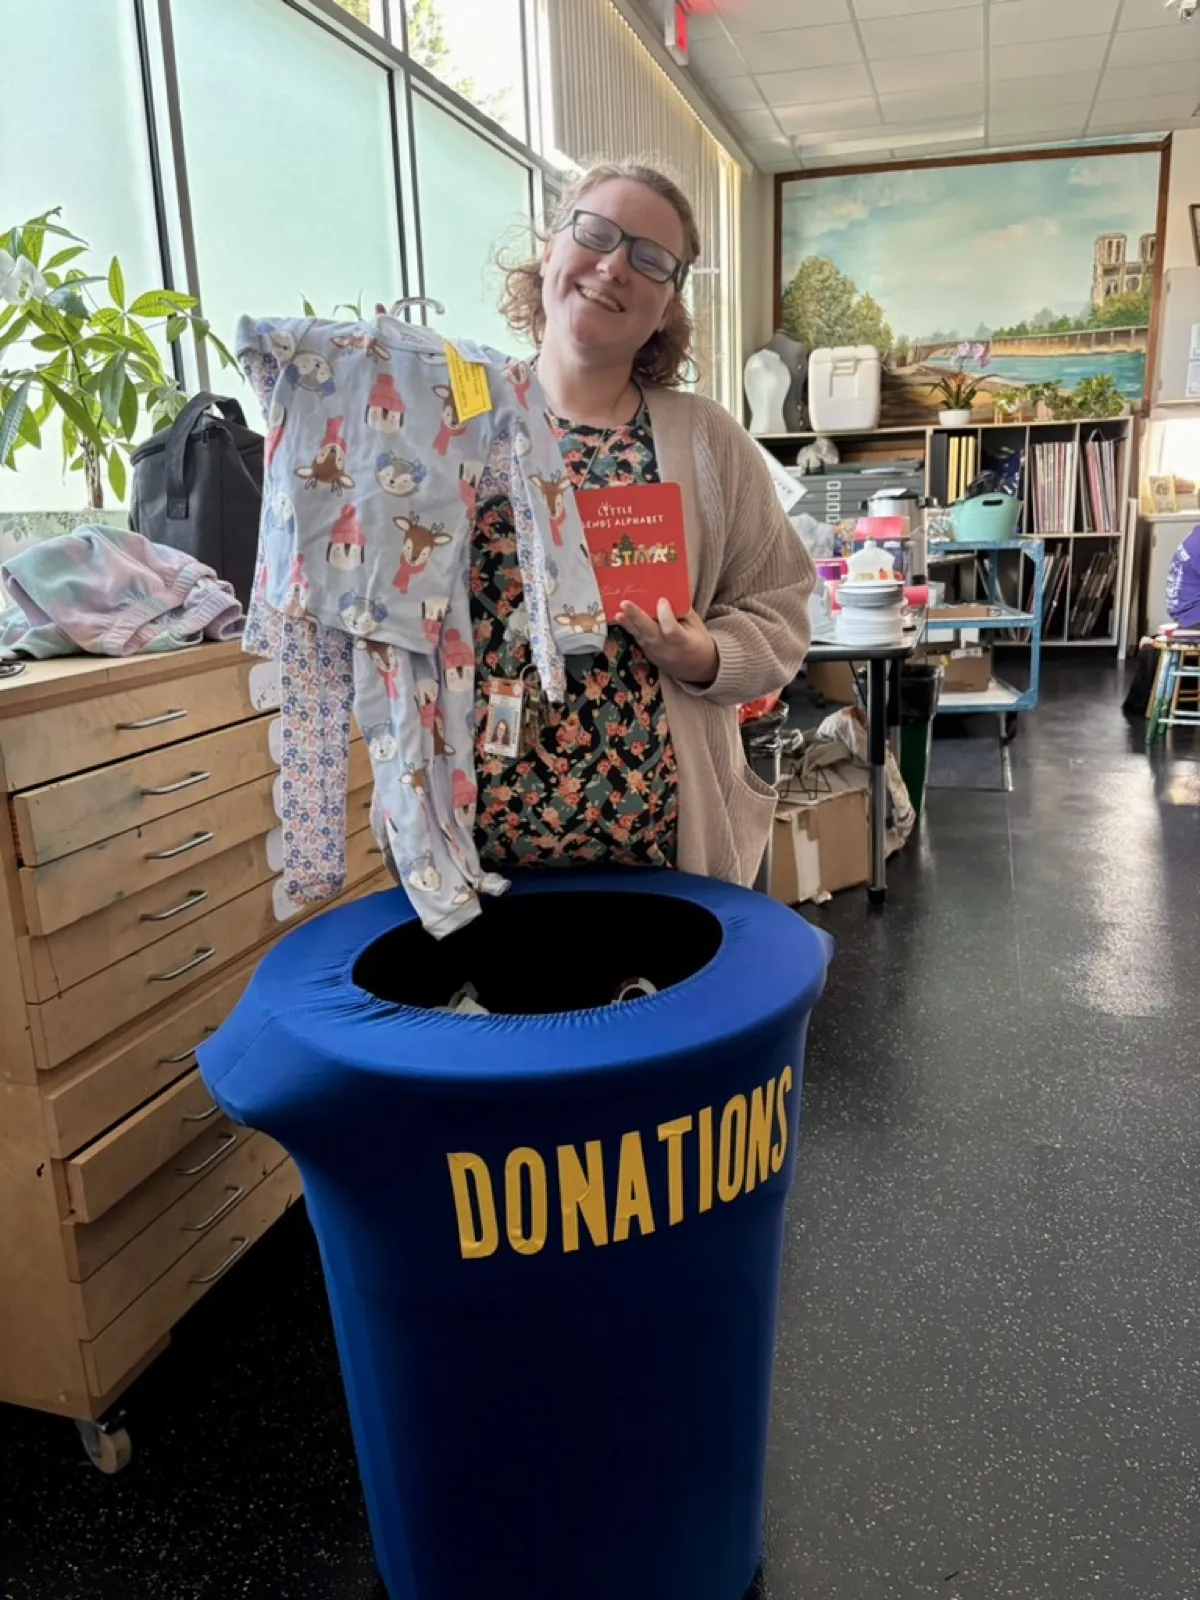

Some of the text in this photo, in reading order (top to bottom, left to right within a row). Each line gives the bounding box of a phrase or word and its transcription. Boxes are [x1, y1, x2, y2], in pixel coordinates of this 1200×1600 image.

[597, 502, 633, 517] LITTLE
[582, 514, 664, 529] ENDS ALPHABET
[446, 1064, 793, 1260] DONATIONS
